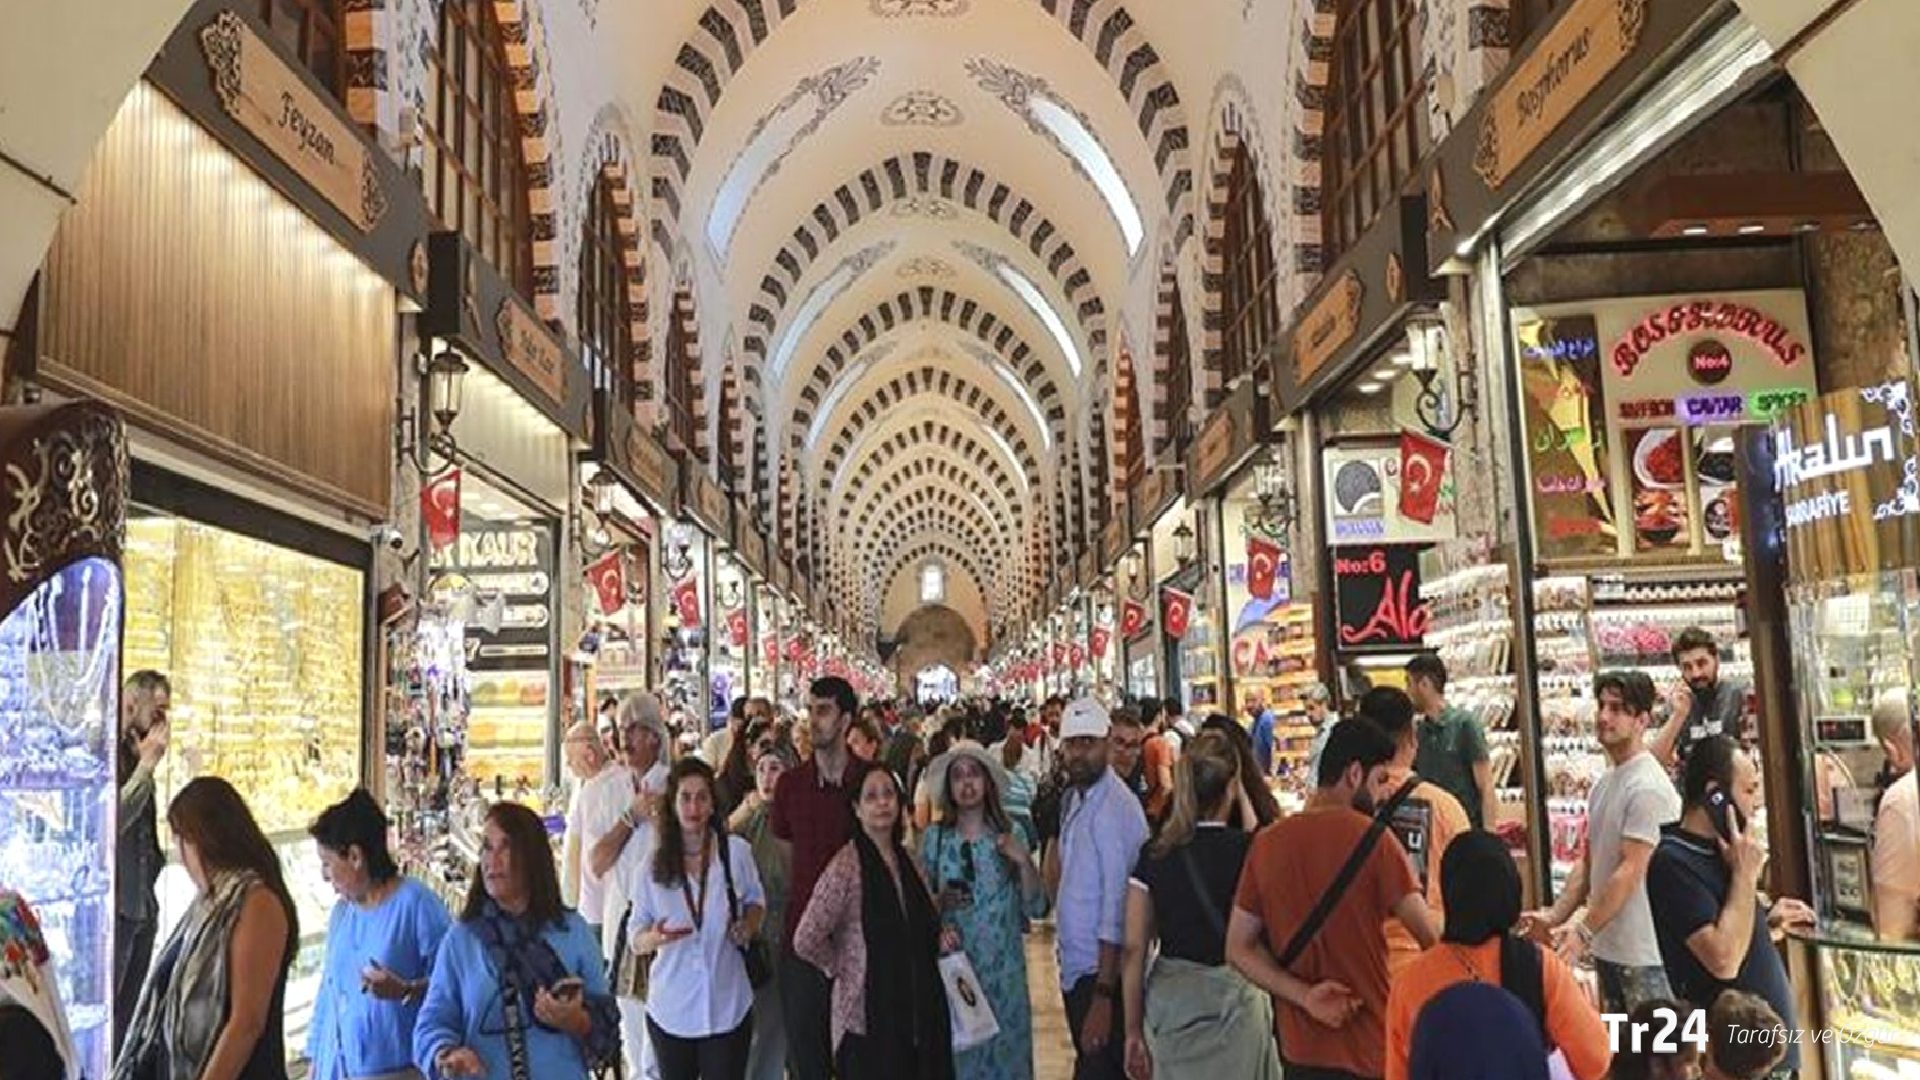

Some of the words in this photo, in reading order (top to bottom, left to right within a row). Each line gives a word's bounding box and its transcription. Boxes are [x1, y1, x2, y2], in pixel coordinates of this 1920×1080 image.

[1517, 26, 1592, 128] Bosphorus
[278, 91, 334, 165] Feyzan
[1686, 396, 1743, 416] CAVIAR
